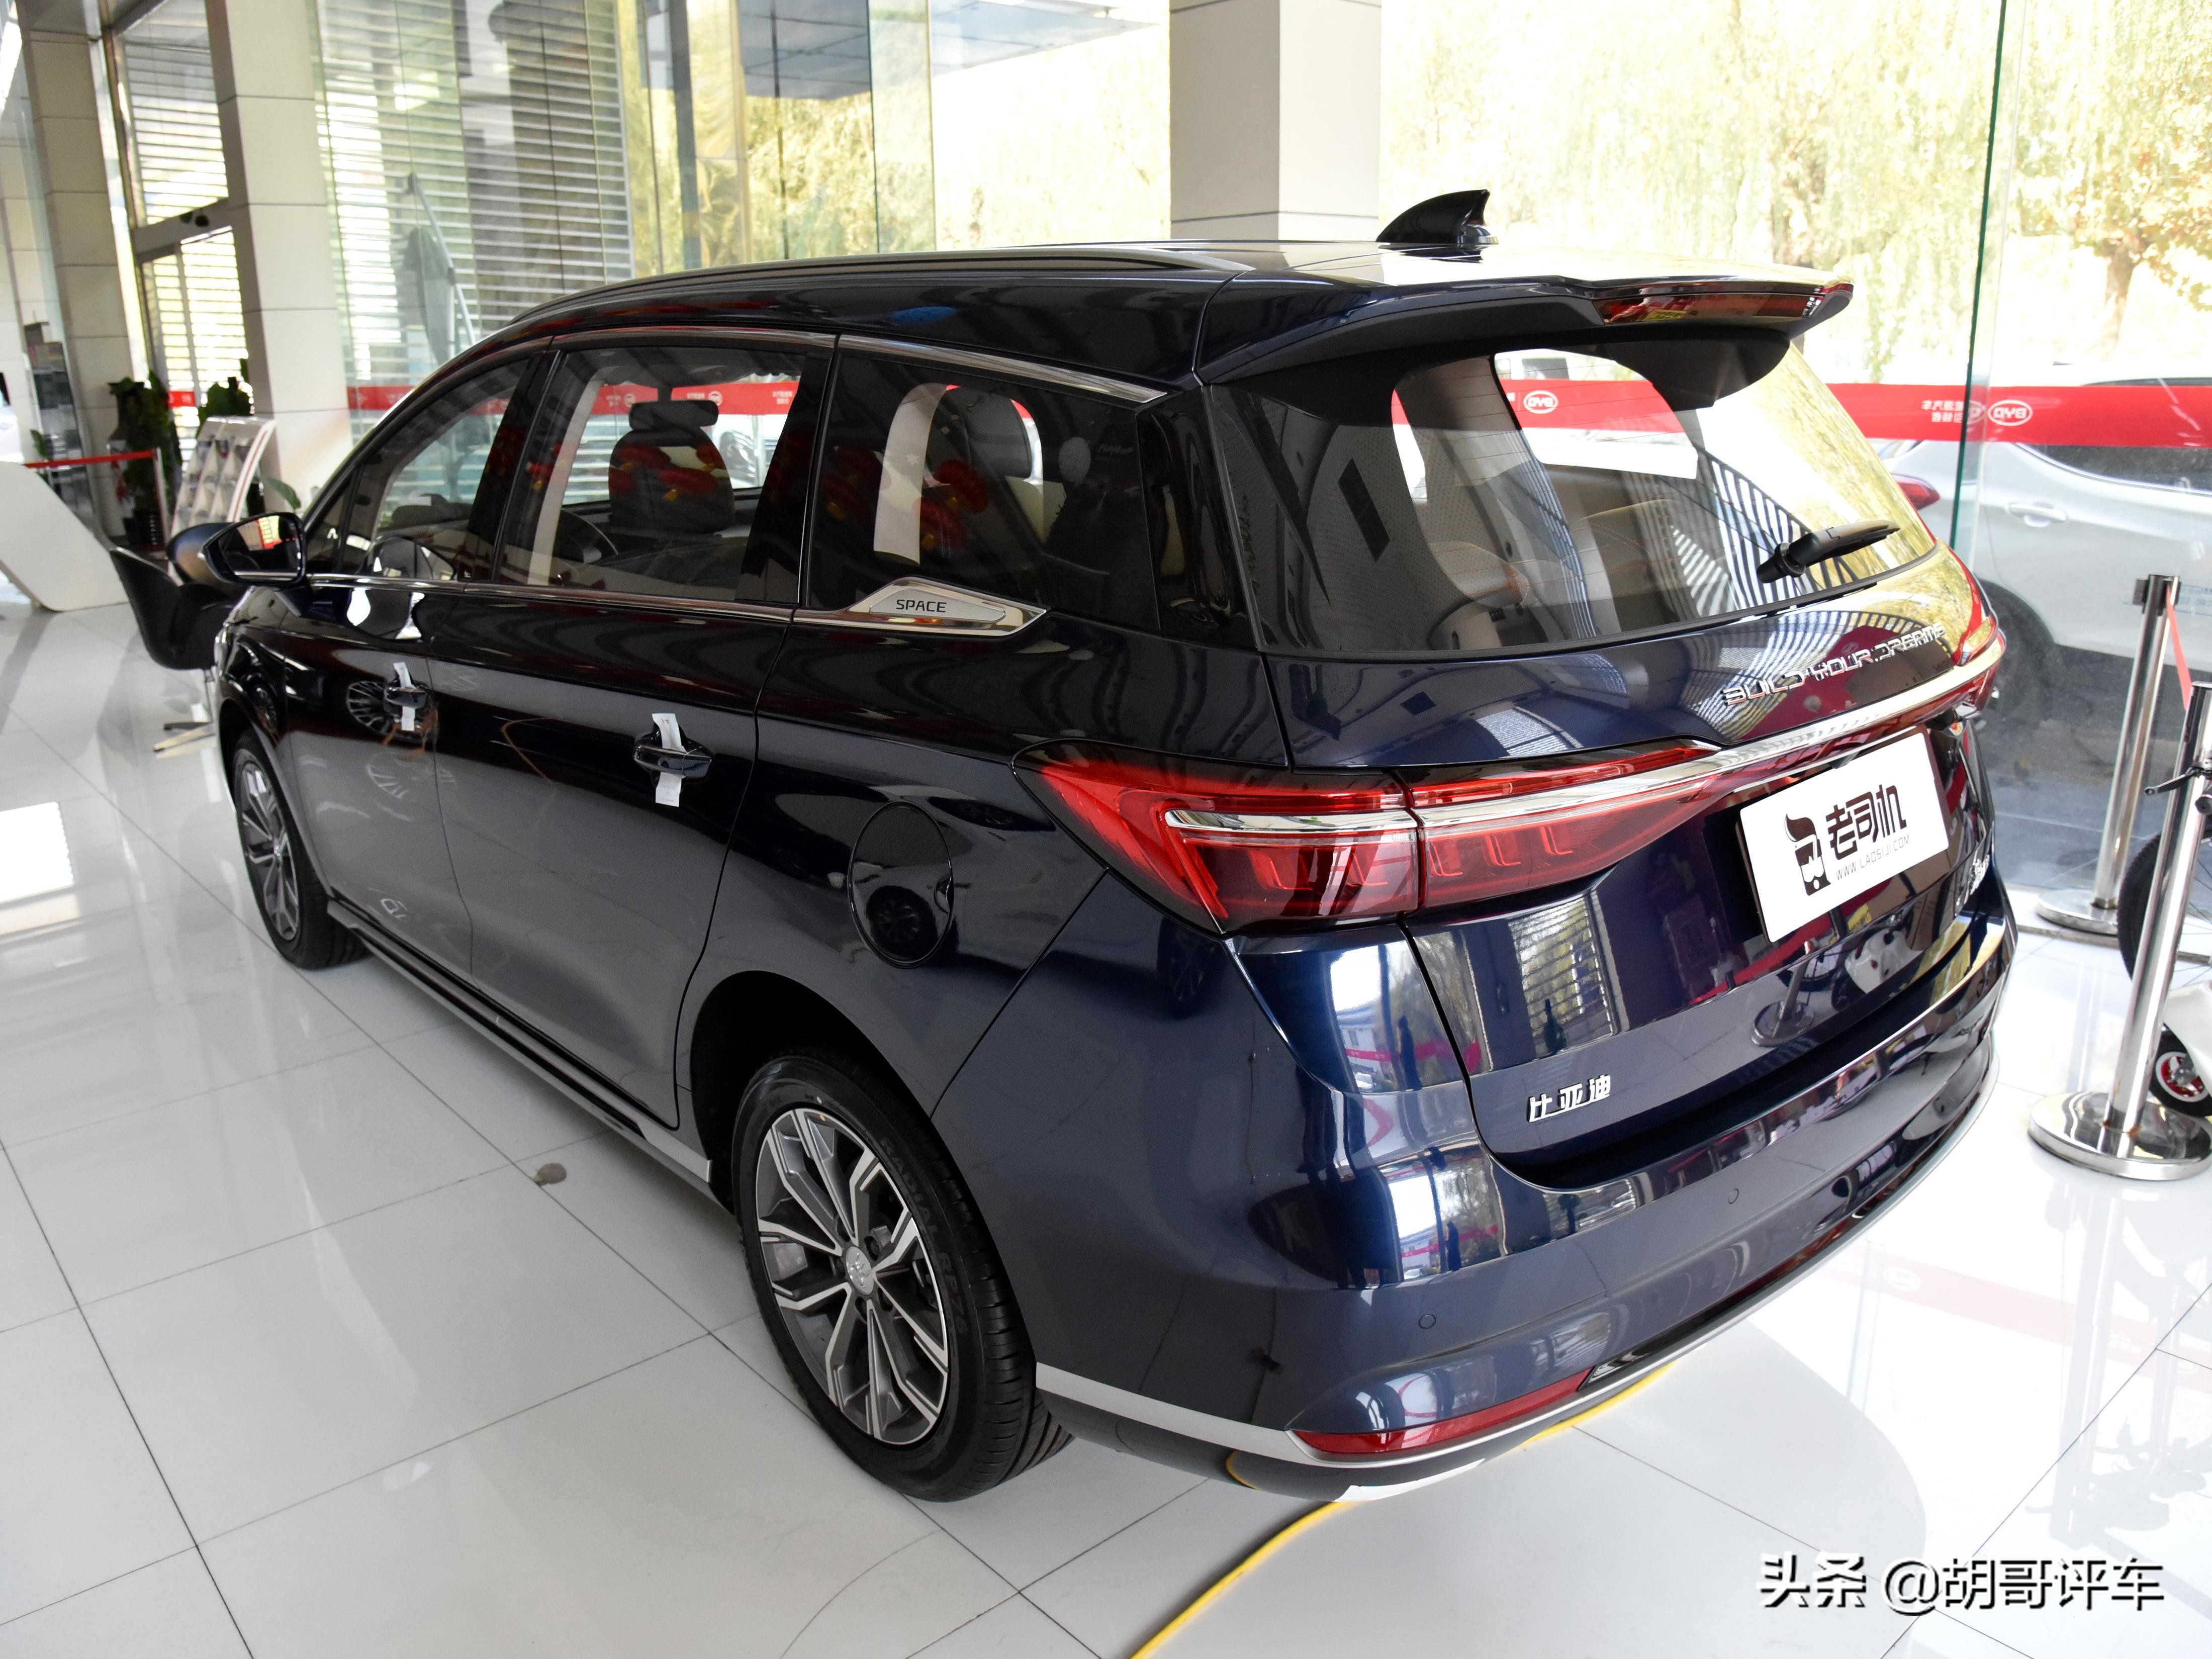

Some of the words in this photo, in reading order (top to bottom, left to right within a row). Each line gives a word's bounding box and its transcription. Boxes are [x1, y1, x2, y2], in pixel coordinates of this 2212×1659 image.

[896, 599, 947, 612] SPACE
[1720, 670, 1805, 706] BUILD
[1807, 649, 1874, 681] YOUR
[1871, 621, 1946, 663] DREAMS
[1825, 783, 1908, 860] 老司机
[1835, 834, 1910, 880] WWW.LAOSIJI.COM
[1527, 1073, 1612, 1123] 比亚迪
[880, 1137, 939, 1240] RADIAL
